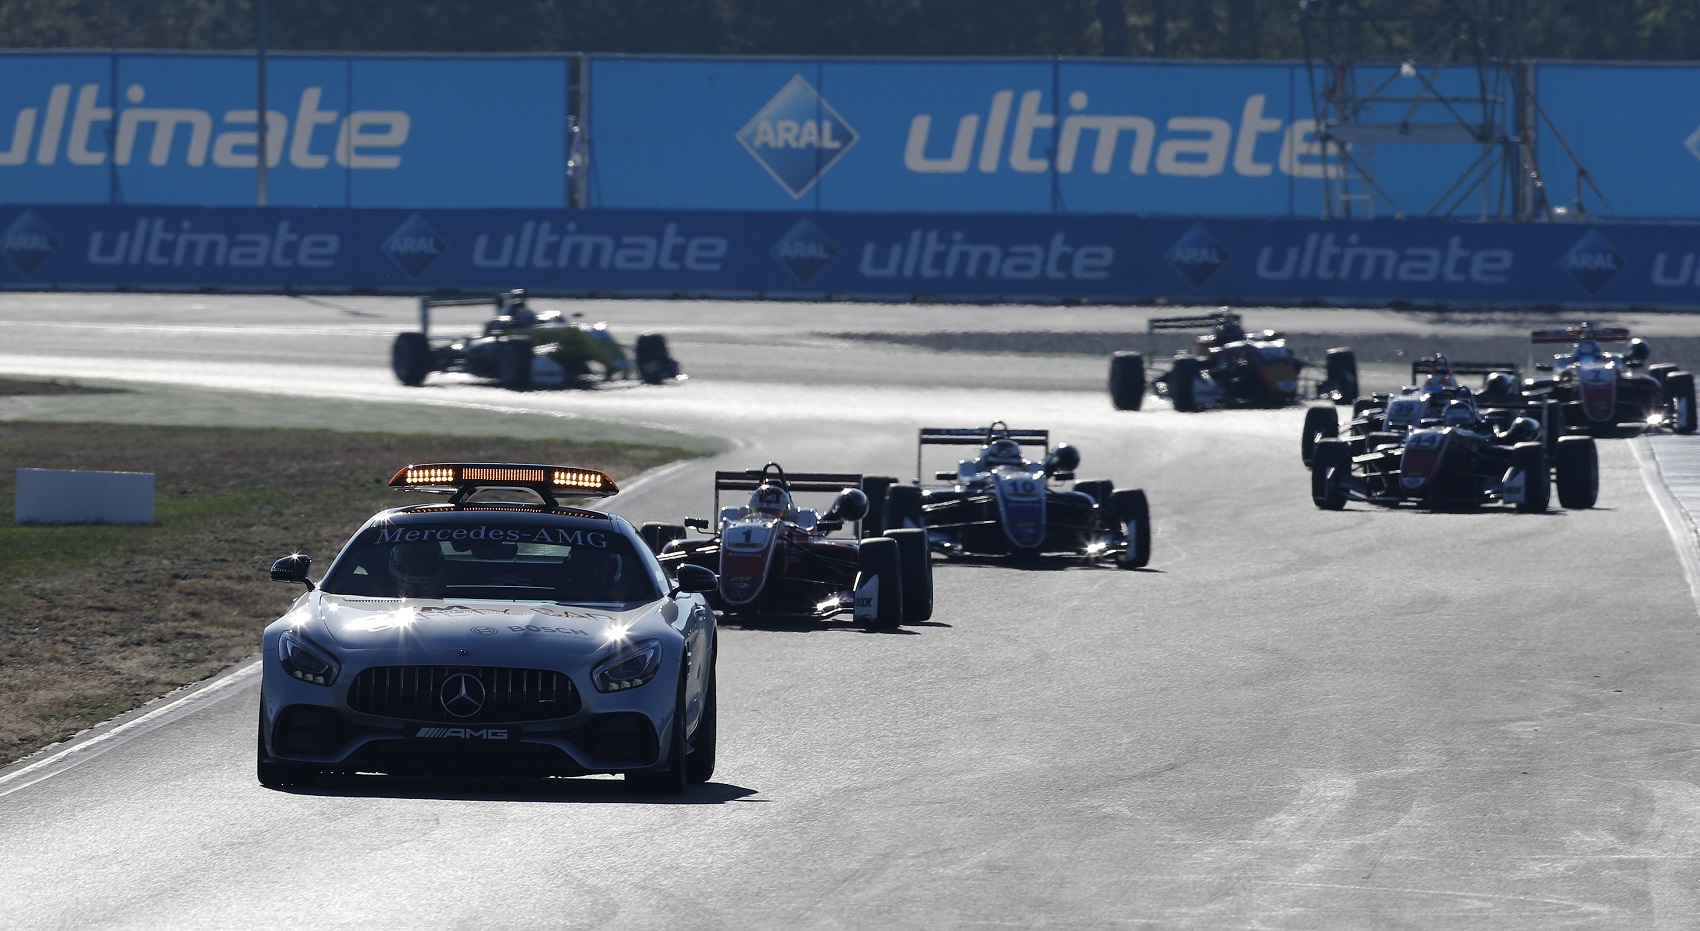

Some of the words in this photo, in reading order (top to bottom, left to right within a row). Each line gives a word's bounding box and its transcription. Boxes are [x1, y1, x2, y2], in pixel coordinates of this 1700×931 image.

[753, 120, 841, 150] ARAL
[904, 91, 1352, 178] ultimate
[87, 217, 340, 269] ultimate
[389, 235, 441, 254] ARAL
[472, 221, 728, 271] ultimate
[778, 240, 829, 261] ARAL
[858, 228, 1115, 280] ultimate
[1173, 245, 1222, 265] ARAL
[1255, 232, 1514, 284] ultimate
[1567, 250, 1617, 270] ARAL
[1409, 434, 1437, 446] 44
[1008, 480, 1036, 493] 10
[374, 524, 609, 549] Mercedes-AMG
[740, 529, 753, 543] 1
[507, 624, 589, 637] BOSCH
[442, 727, 509, 741] AMG
